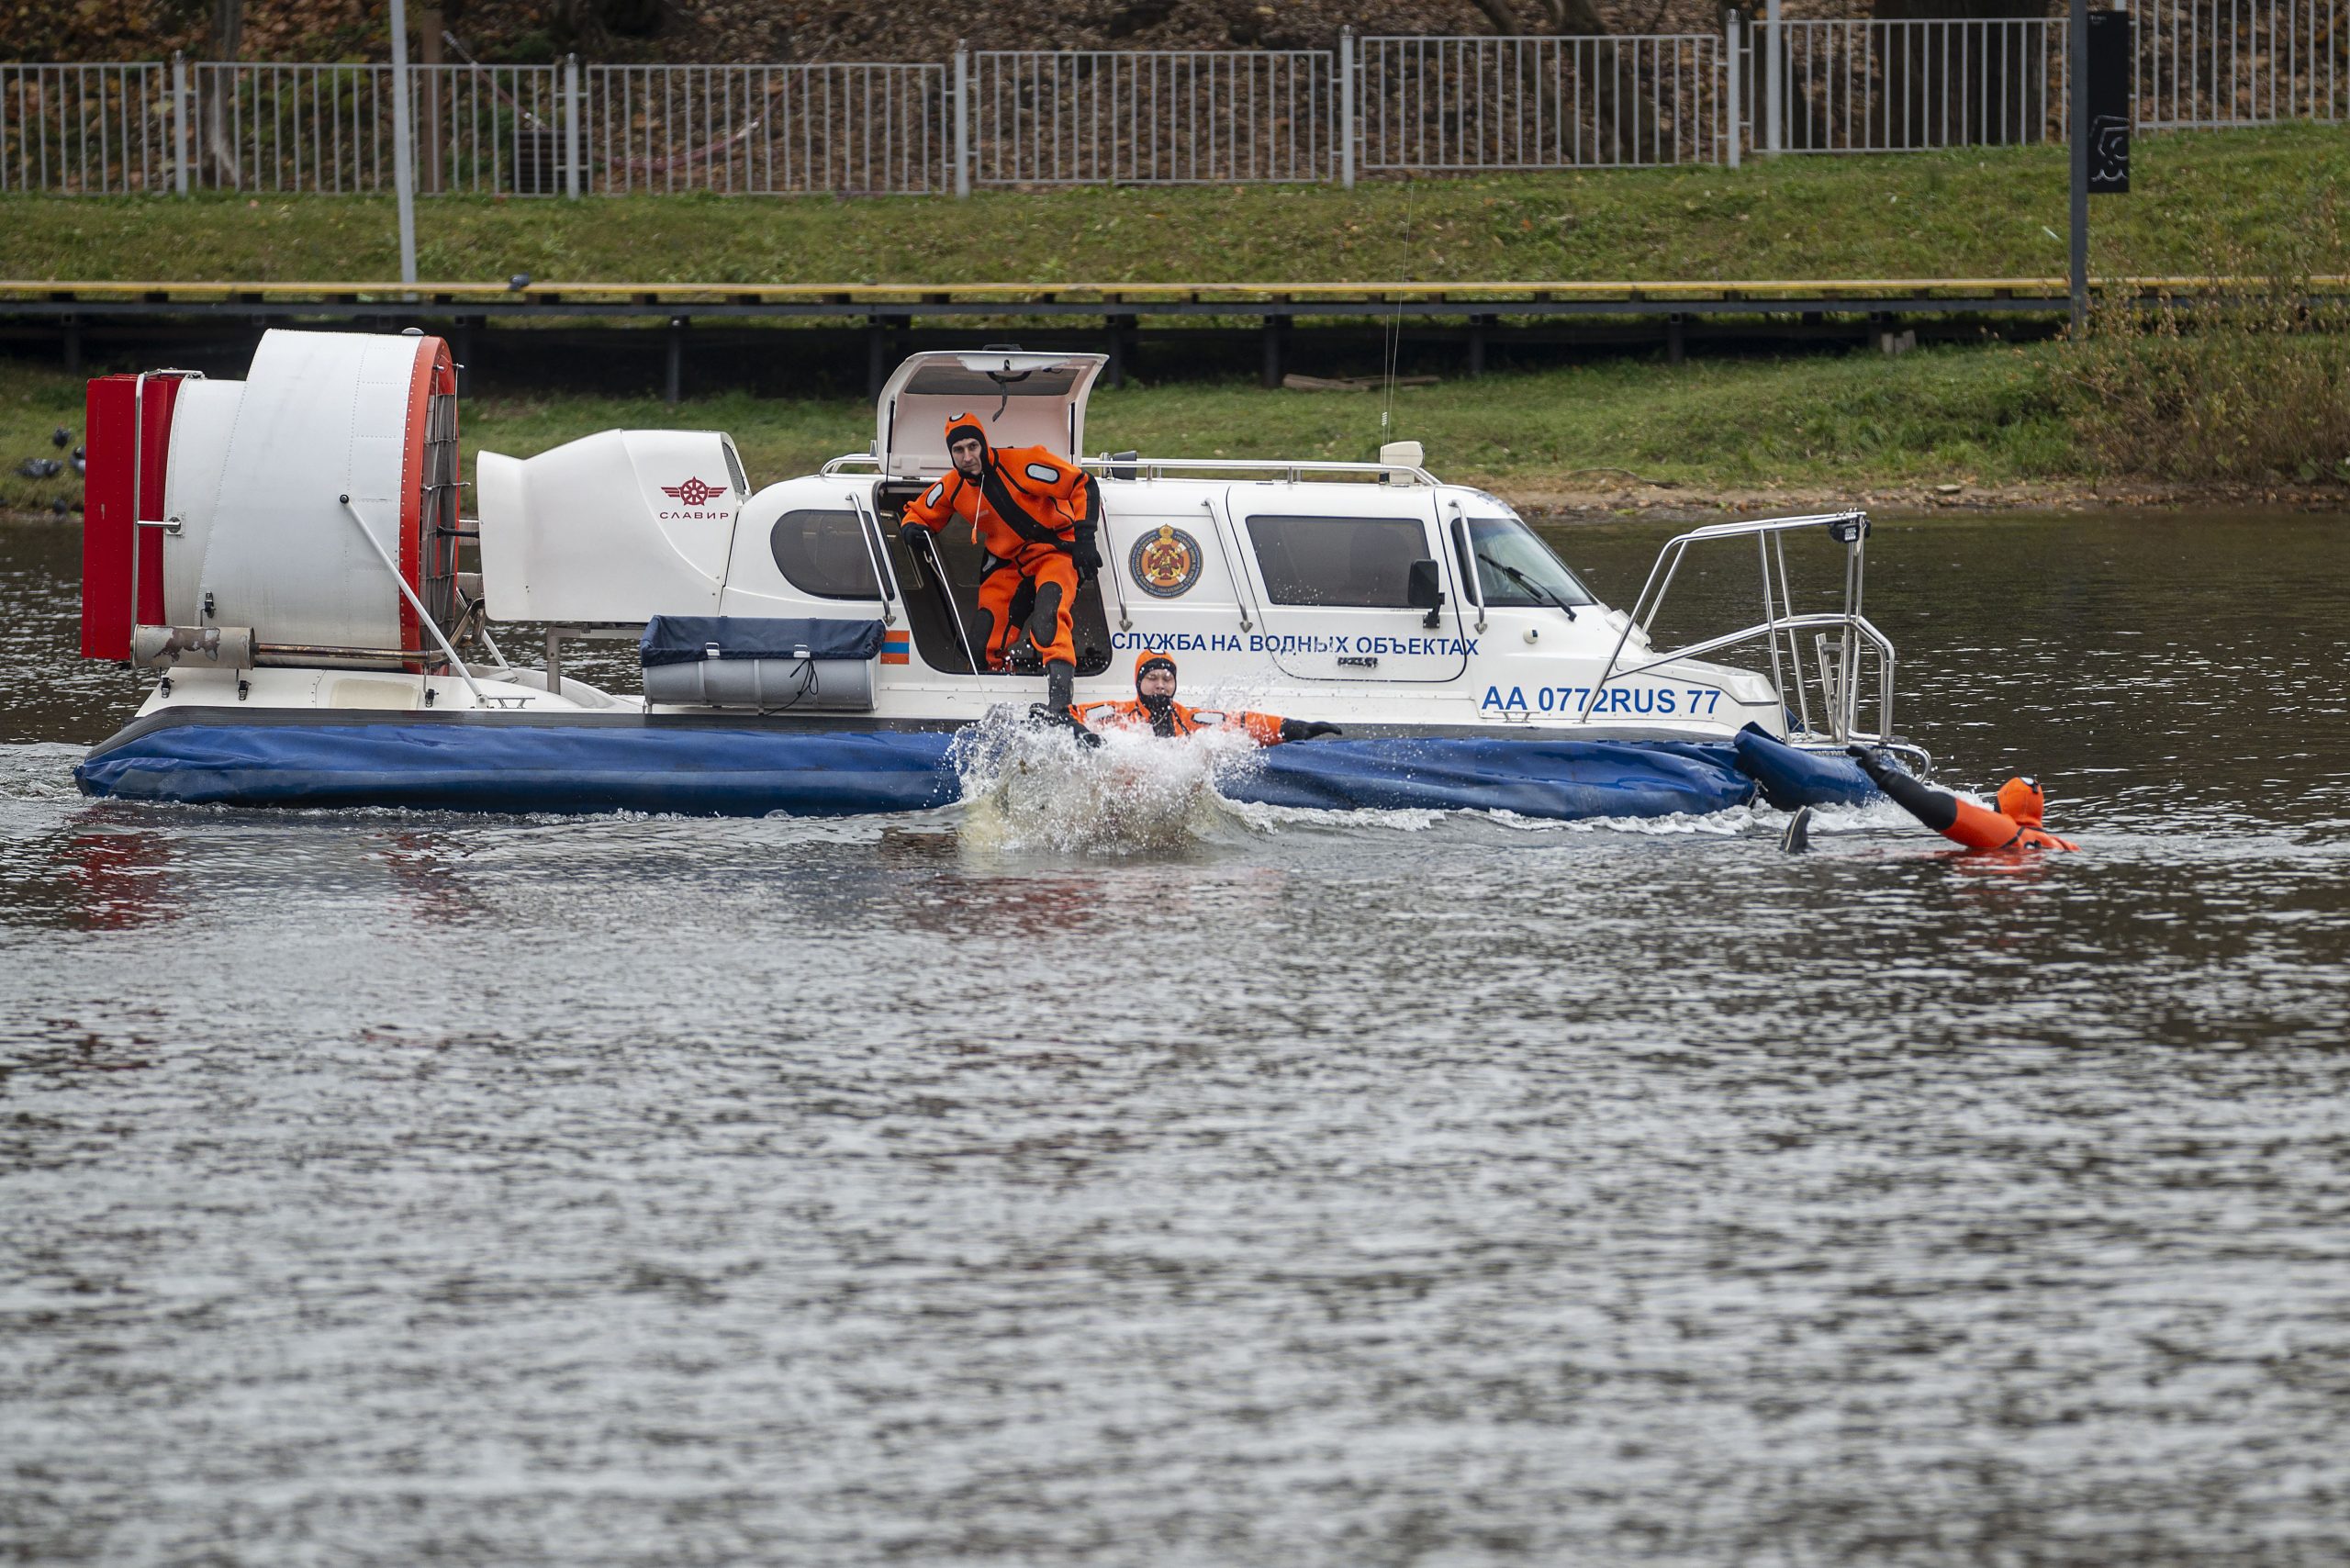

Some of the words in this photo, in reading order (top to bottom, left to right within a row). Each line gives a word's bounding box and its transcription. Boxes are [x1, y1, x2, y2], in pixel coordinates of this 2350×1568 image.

[659, 511, 729, 520] СЛАВИР
[1112, 633, 1206, 651] СЛУЖБА
[1211, 634, 1242, 651] НА
[1249, 634, 1348, 655] ВОДНЫХ
[1356, 636, 1479, 655] ОБЪЕКТАХ
[1482, 686, 1528, 710] AA
[1687, 690, 1721, 713] 77
